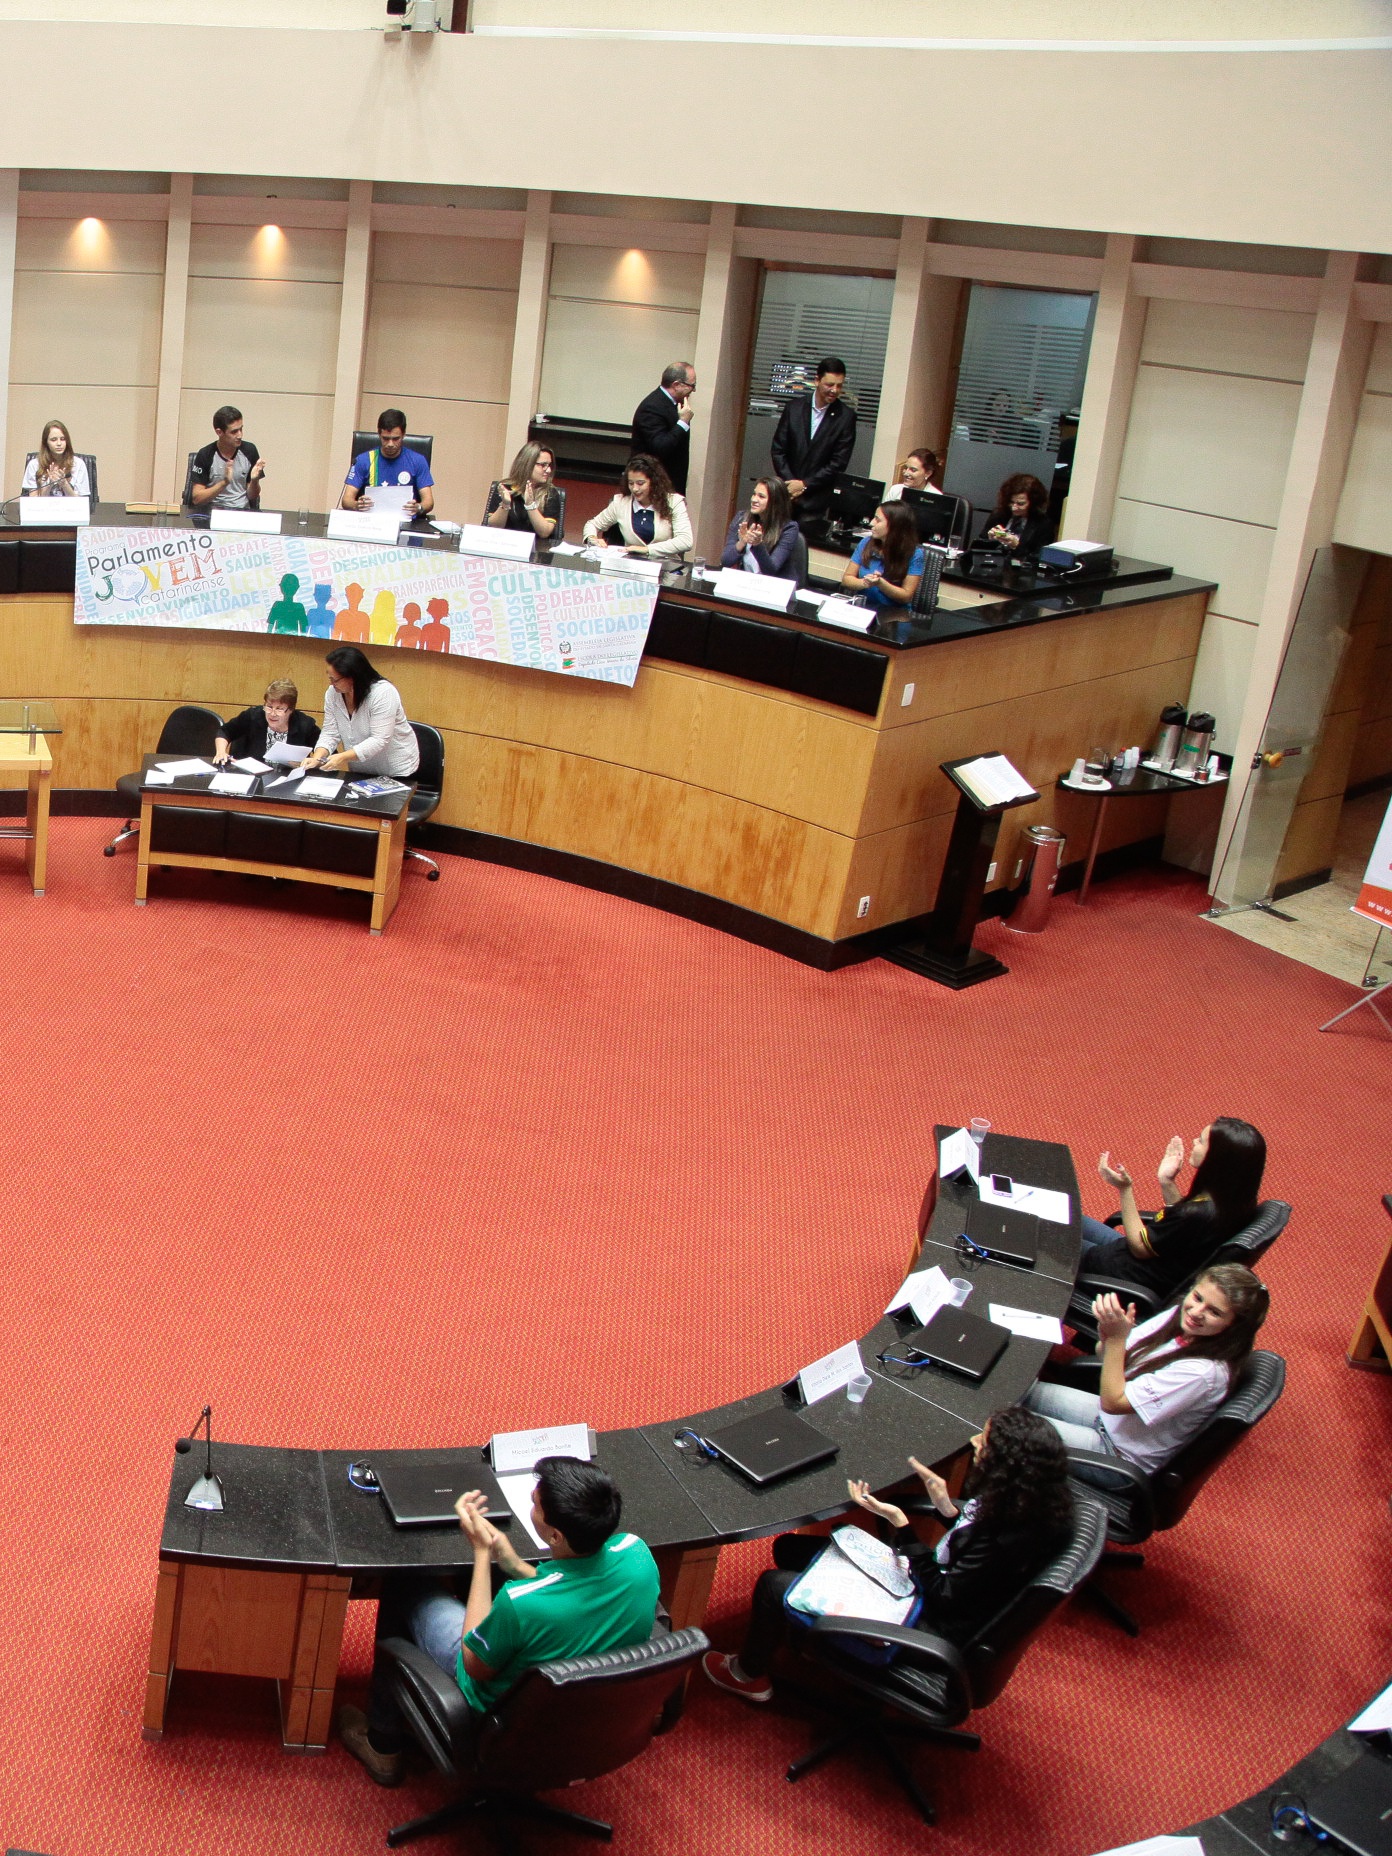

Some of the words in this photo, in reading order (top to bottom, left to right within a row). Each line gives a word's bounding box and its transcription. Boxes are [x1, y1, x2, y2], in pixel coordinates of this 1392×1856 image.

[87, 534, 212, 575] Parlamento
[219, 538, 268, 558] DEBATE
[95, 549, 222, 606] JOVEM
[141, 576, 226, 605] catarinense
[488, 567, 597, 597] CULTURA
[550, 584, 615, 609] DEBATE
[553, 605, 606, 622] CULTURA
[556, 613, 649, 639] SOCIEDADE
